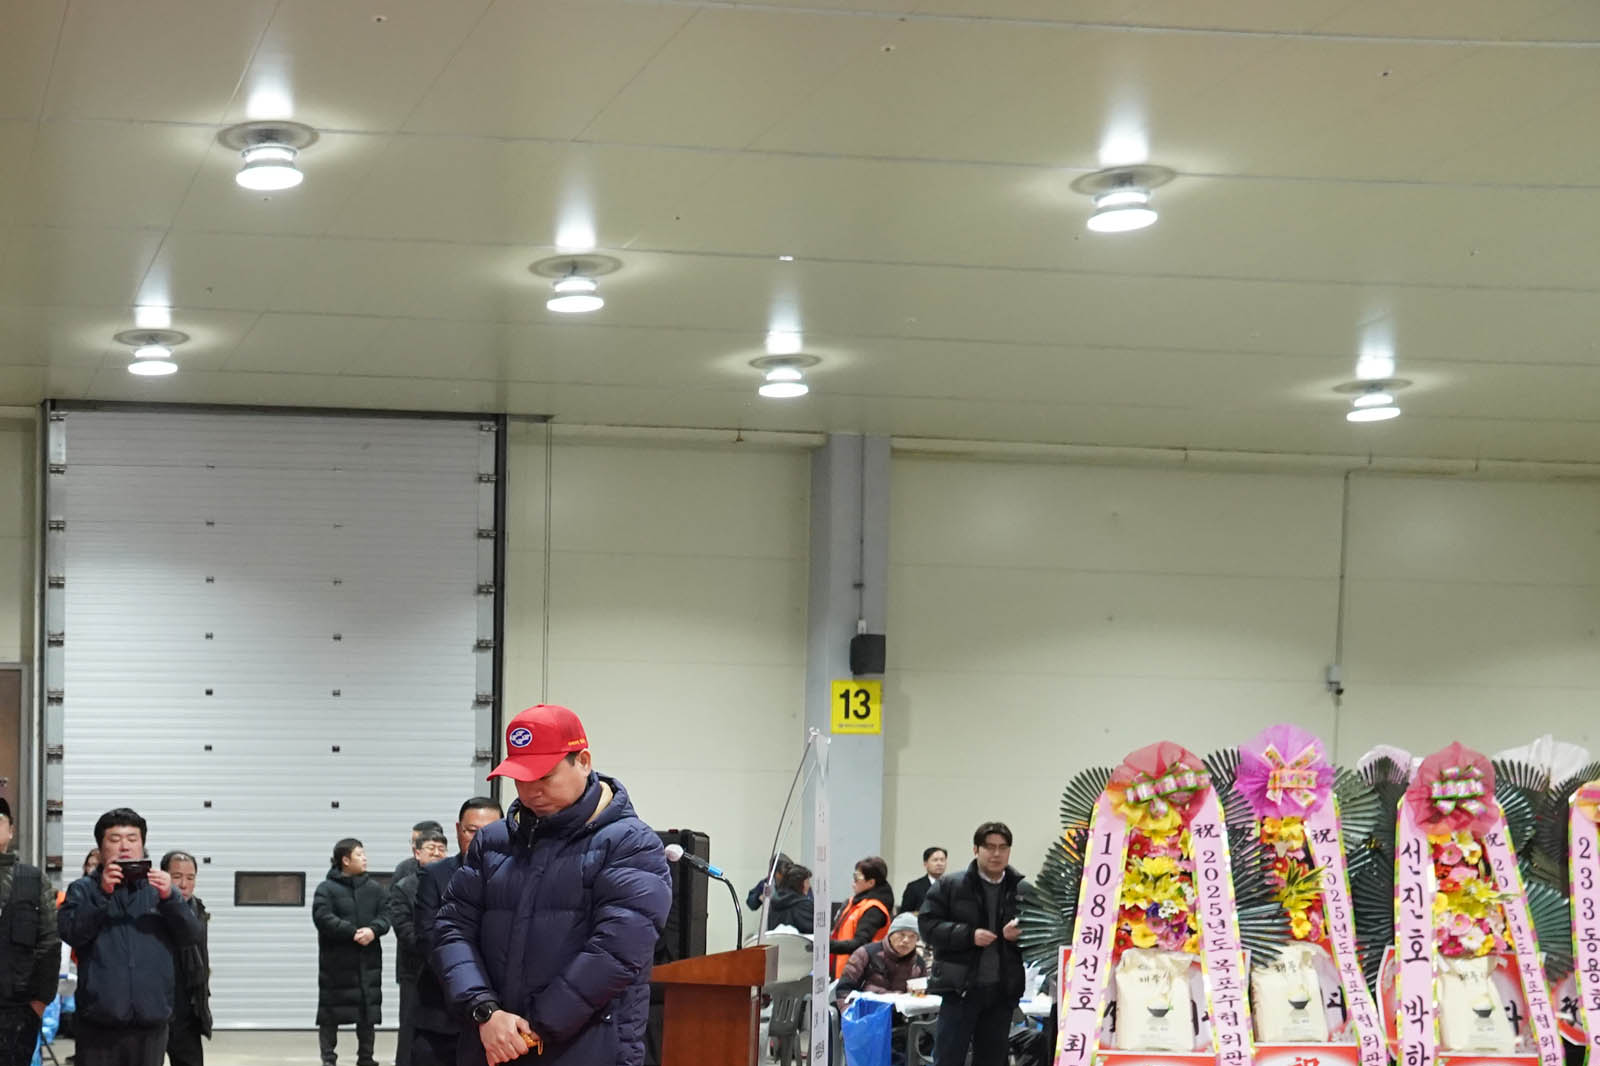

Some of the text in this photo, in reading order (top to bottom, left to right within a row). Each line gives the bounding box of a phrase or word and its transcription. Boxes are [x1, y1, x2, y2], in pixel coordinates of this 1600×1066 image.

[839, 688, 871, 720] 13
[1193, 824, 1220, 839] 祝
[1071, 832, 1113, 1012] 108해선호
[1401, 838, 1430, 964] 선진호
